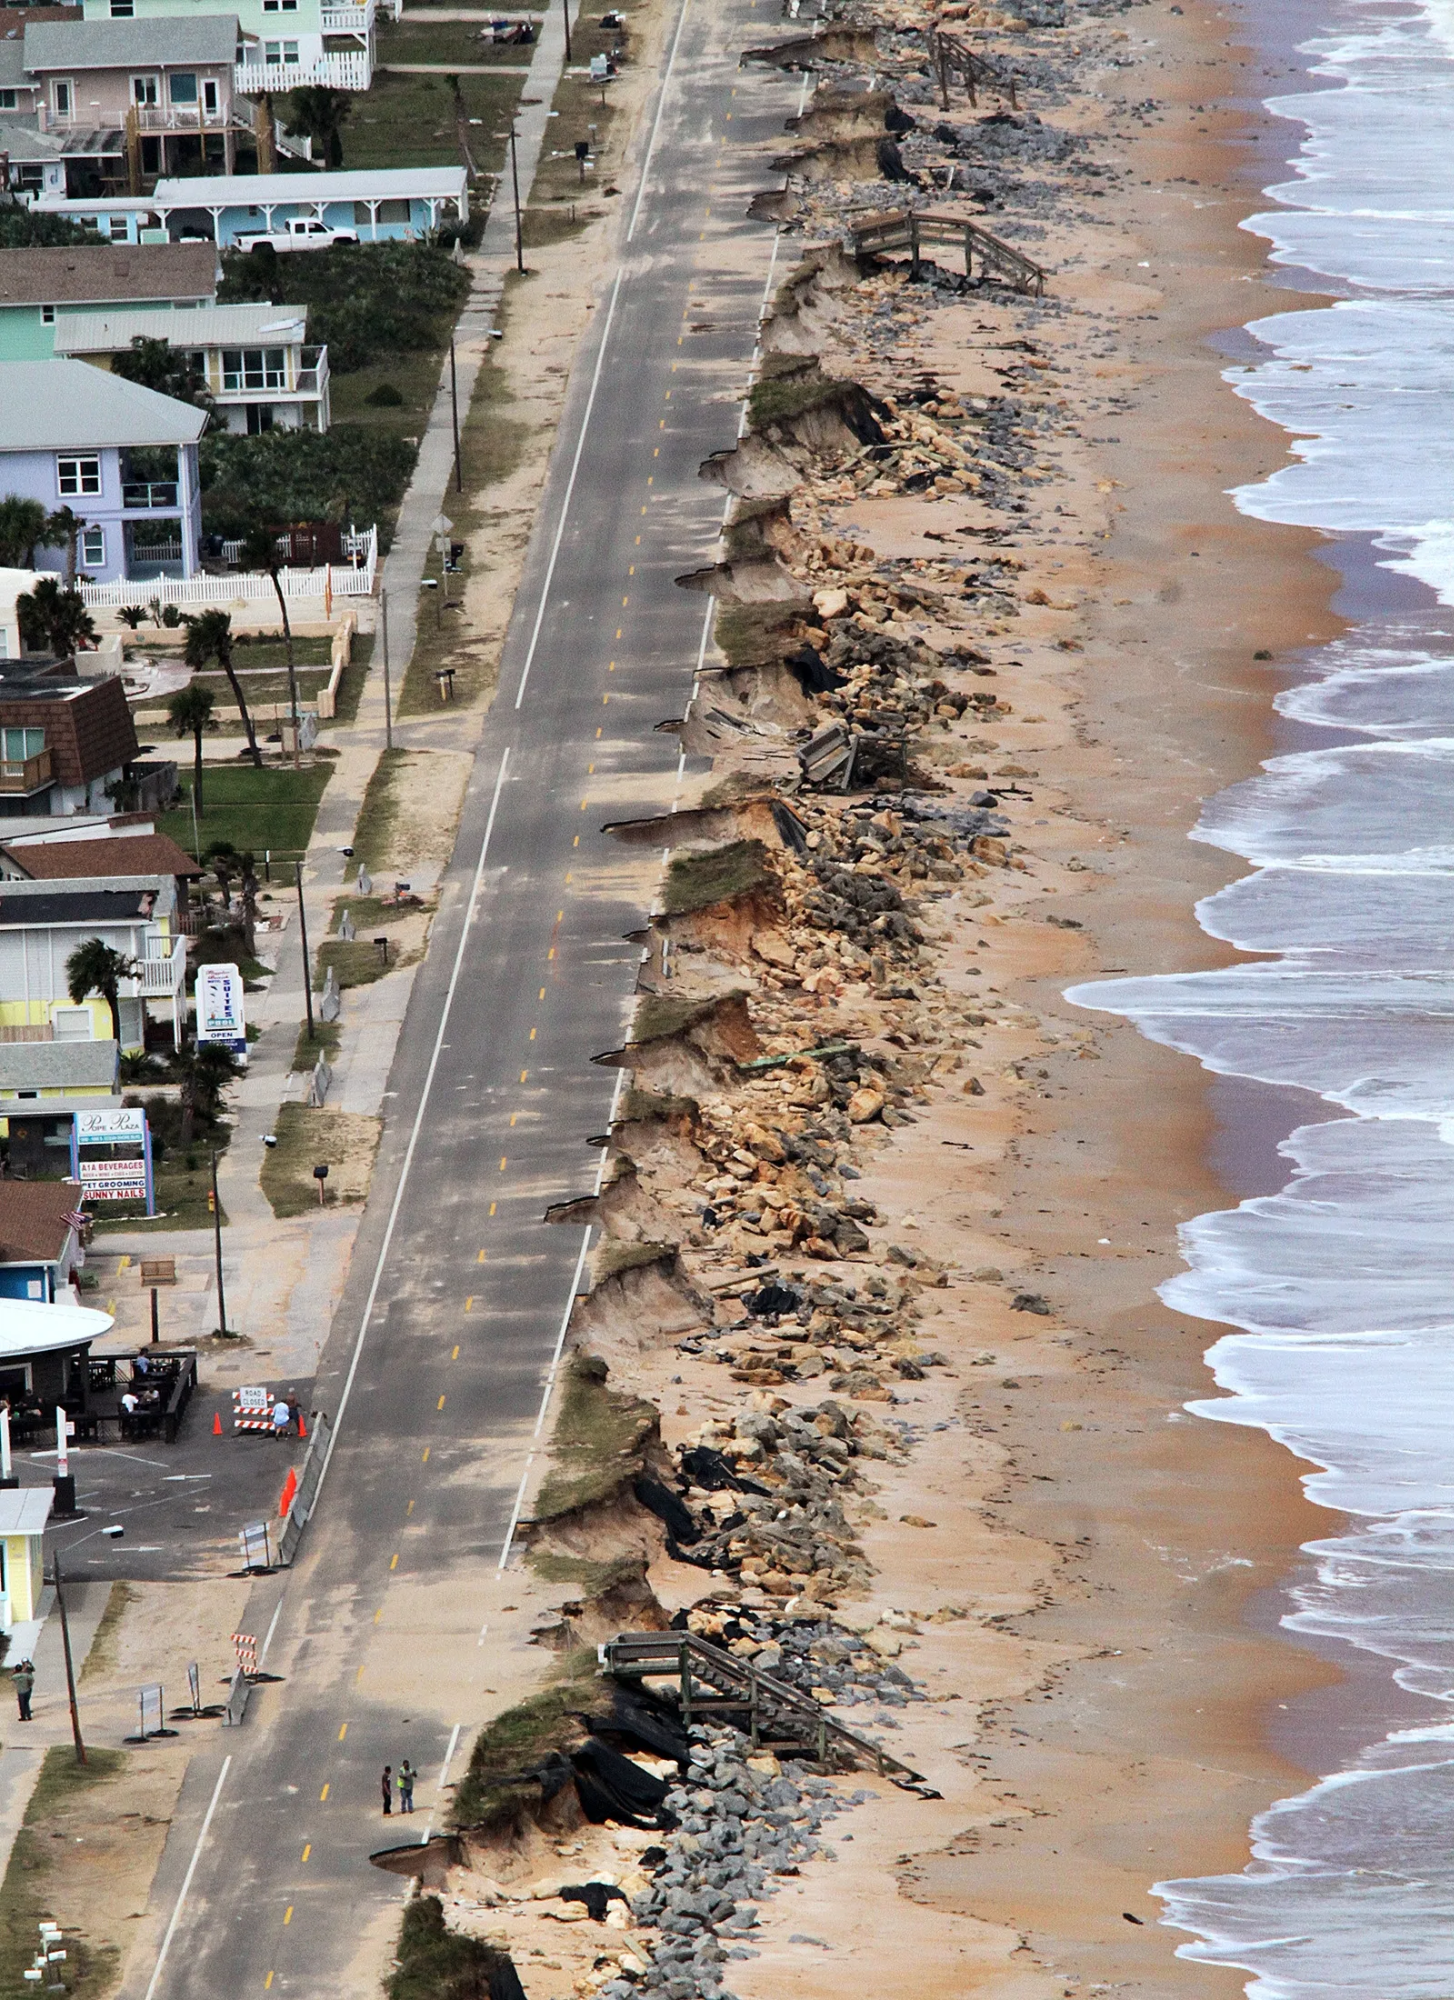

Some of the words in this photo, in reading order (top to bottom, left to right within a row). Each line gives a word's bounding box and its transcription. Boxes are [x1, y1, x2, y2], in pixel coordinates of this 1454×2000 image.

[223, 980, 232, 1017] SUITES
[98, 1162, 143, 1170] BEVERAGES
[83, 1190, 113, 1199] SUNNY
[117, 1189, 144, 1198] NAILS
